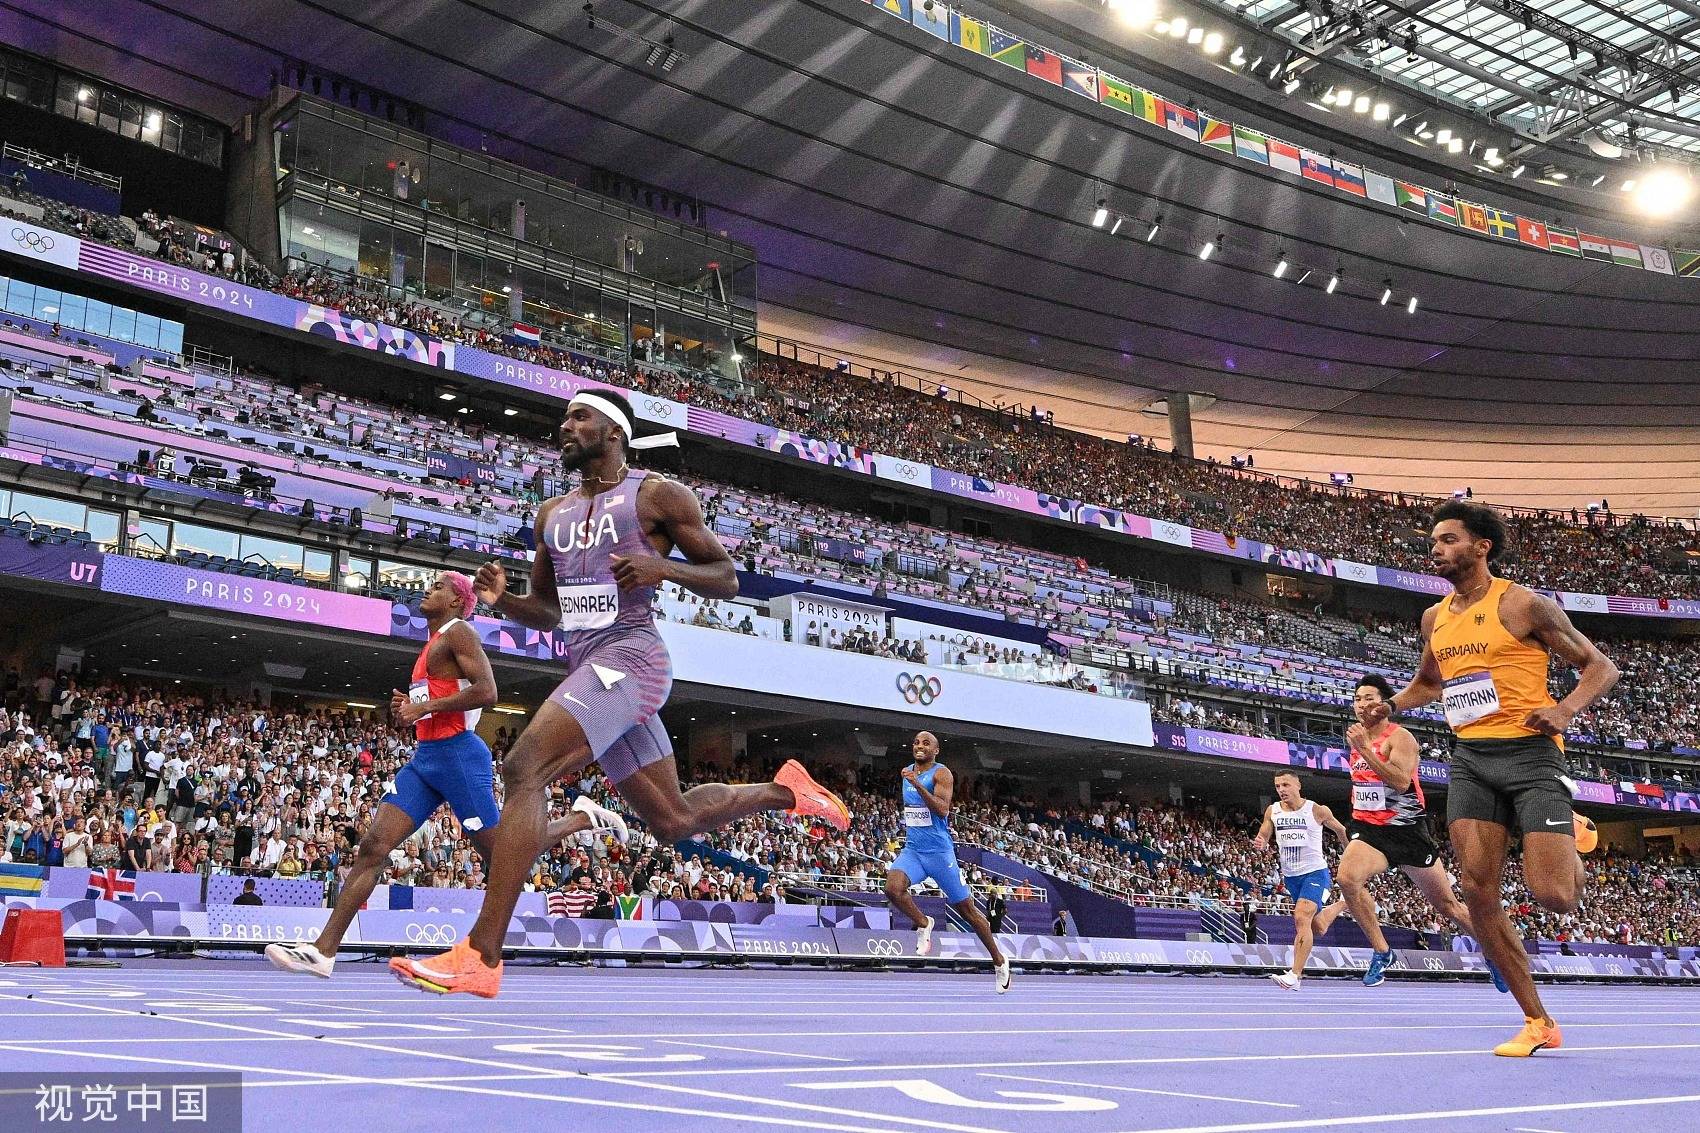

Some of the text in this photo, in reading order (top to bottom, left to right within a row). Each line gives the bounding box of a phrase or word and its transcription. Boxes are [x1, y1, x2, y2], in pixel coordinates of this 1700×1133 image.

[199, 282, 253, 309] 2024
[549, 377, 587, 394] 202
[426, 457, 447, 470] U14
[477, 467, 495, 481] U13
[553, 513, 619, 553] USA
[853, 549, 865, 559] U11
[70, 562, 98, 583] U7
[263, 591, 320, 615] 2024
[843, 609, 878, 626] 2024
[555, 640, 568, 656] U
[1435, 642, 1489, 662] GERMANY
[1171, 735, 1186, 747] S13
[1232, 741, 1259, 753] 2024
[1277, 817, 1307, 826] CZECHIA
[791, 941, 830, 955] 2024
